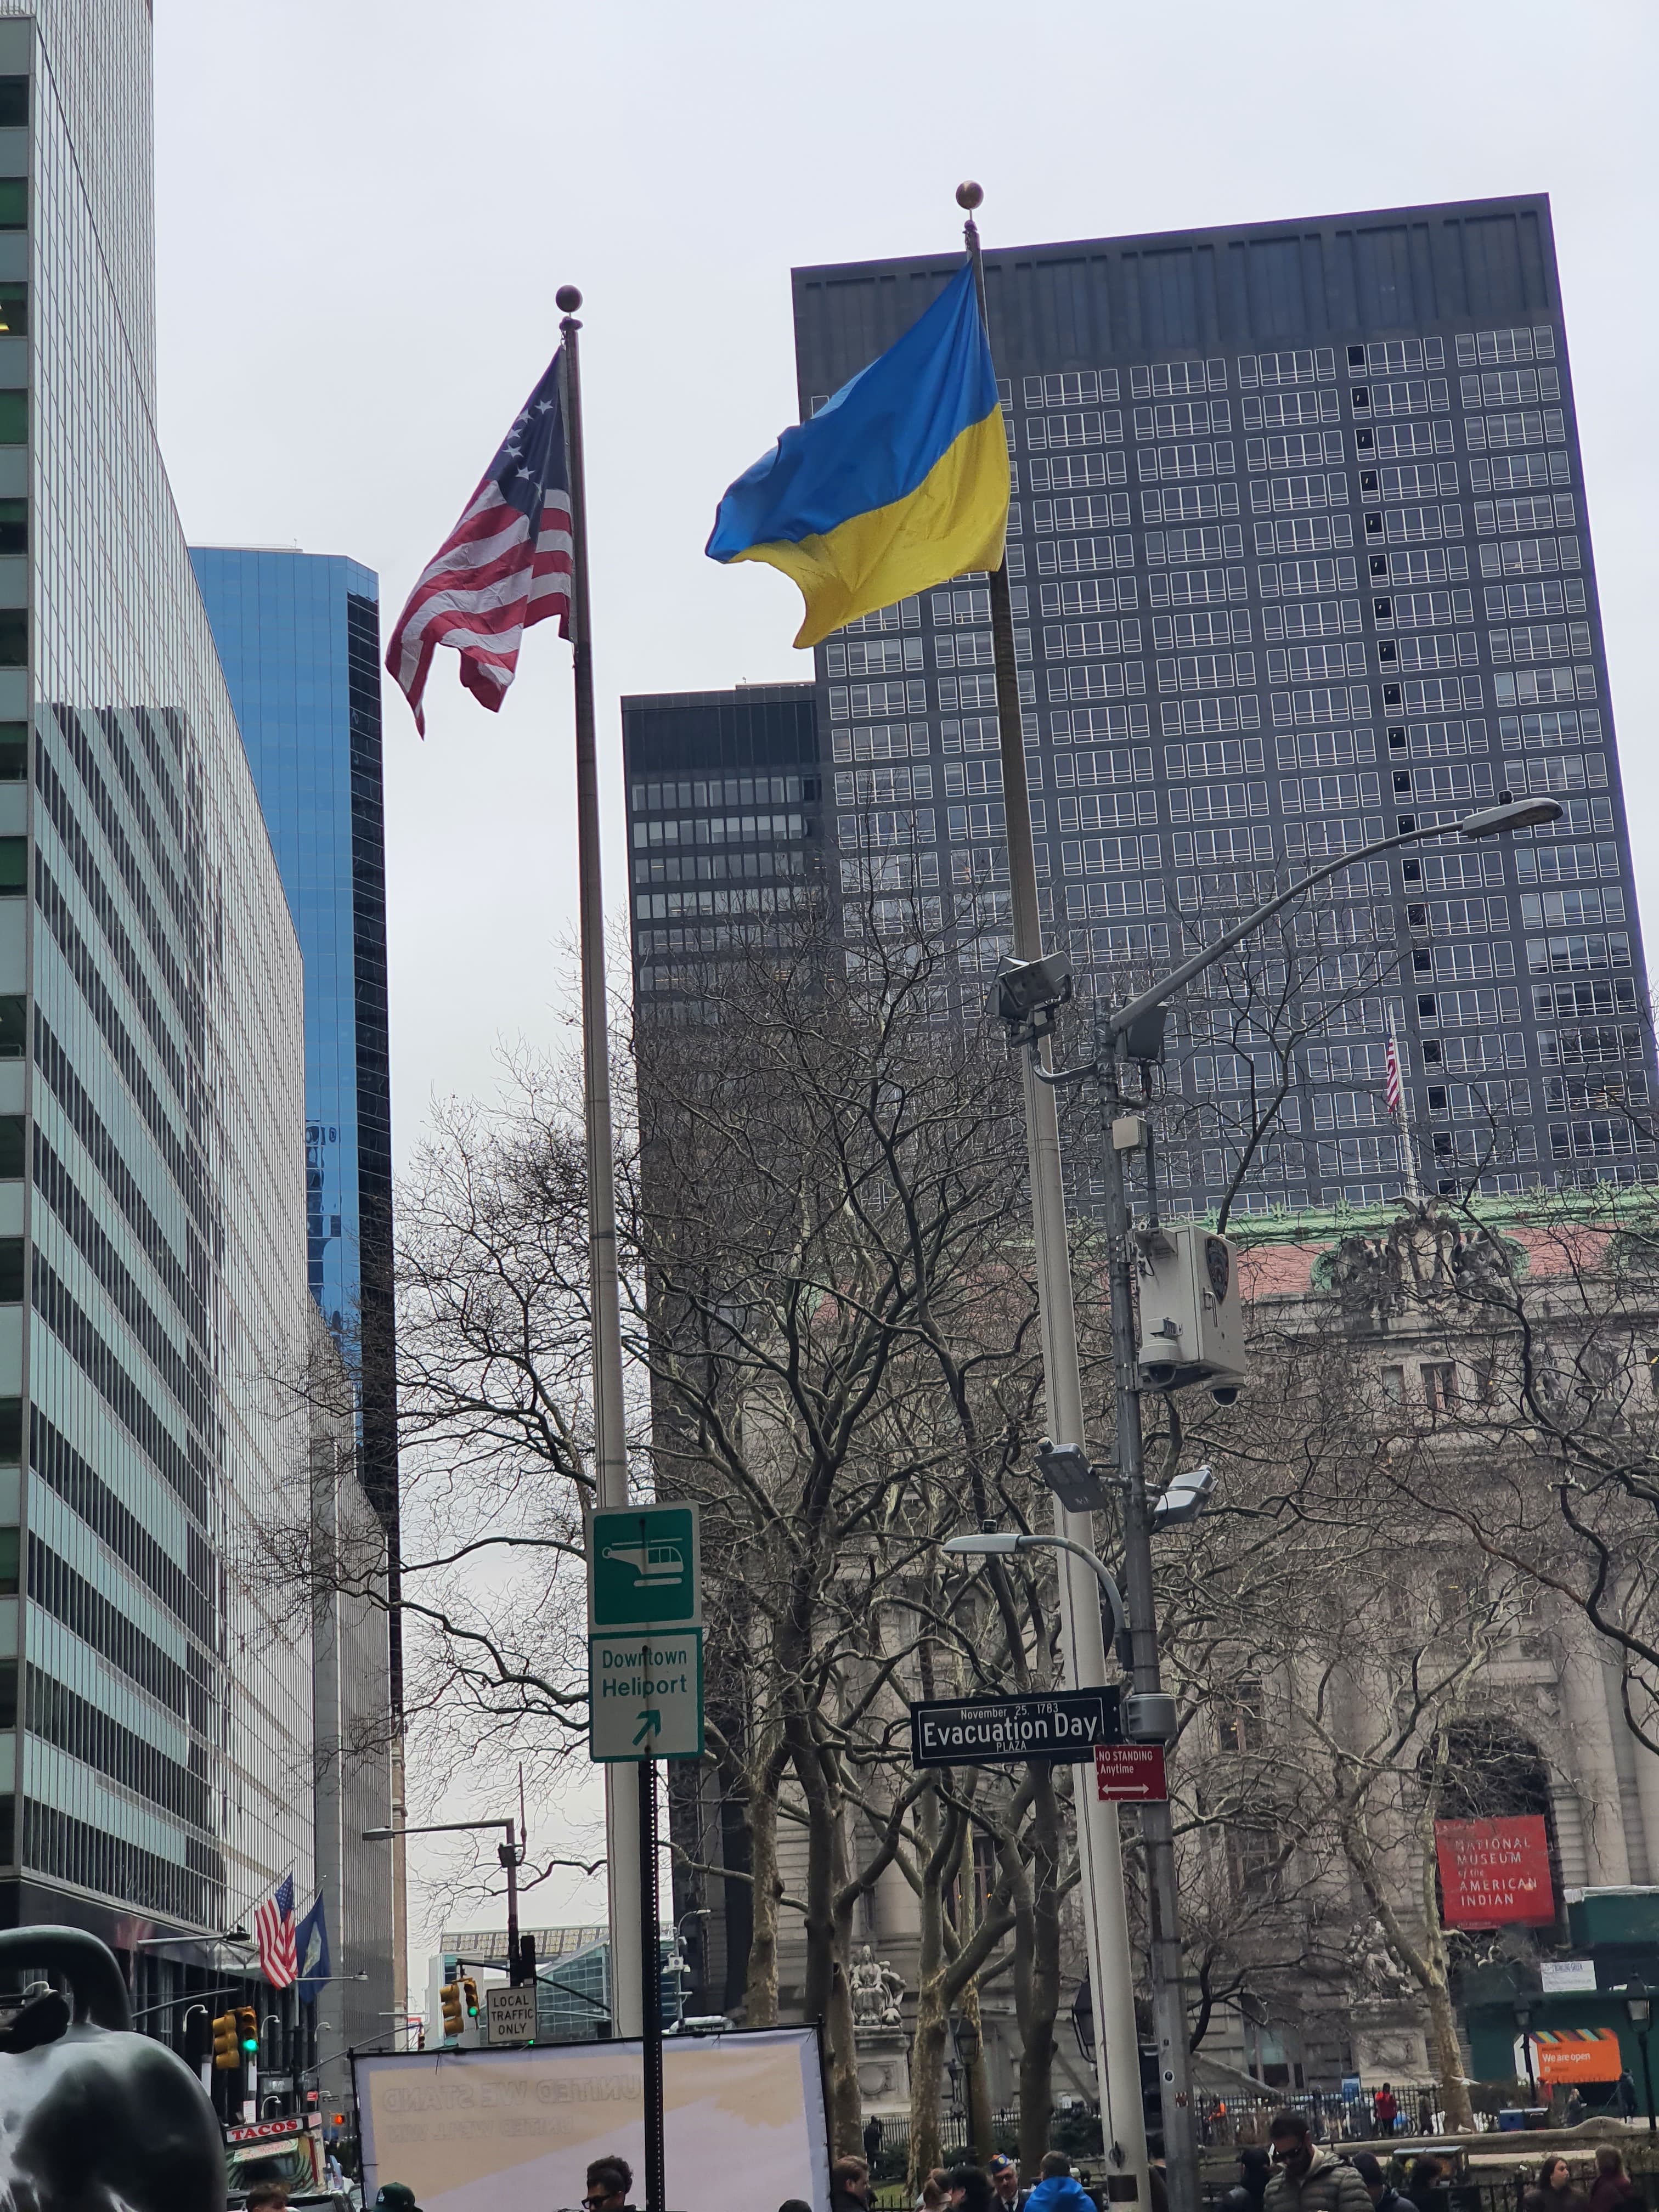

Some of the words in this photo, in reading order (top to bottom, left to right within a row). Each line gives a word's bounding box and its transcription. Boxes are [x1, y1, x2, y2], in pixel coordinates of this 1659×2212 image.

[602, 1648, 687, 1668] Downtown
[603, 1674, 687, 1699] Heliport
[961, 1708, 1007, 1720] November
[1037, 1702, 1058, 1714] 1783
[924, 1716, 1048, 1747] Evacuation
[1054, 1713, 1097, 1741] Day
[996, 1741, 1027, 1752] PLAZA
[1099, 1751, 1111, 1761] NO
[1113, 1751, 1153, 1761] STANDING
[1101, 1763, 1134, 1776] Anytime
[1455, 1837, 1531, 1852] NATIONAL
[1457, 1852, 1521, 1865] MUSEUM
[1458, 1870, 1466, 1879] of
[1470, 1869, 1483, 1877] the
[1460, 1878, 1537, 1892] AMERICAN
[1462, 1893, 1514, 1906] INDIAN
[494, 1995, 529, 2007] LOCAL
[492, 2009, 534, 2021] TRAFFIC
[499, 2023, 527, 2035] ONLY
[1542, 2053, 1556, 2062] We
[1571, 2053, 1590, 2063] open
[232, 2120, 298, 2140] TACOS
